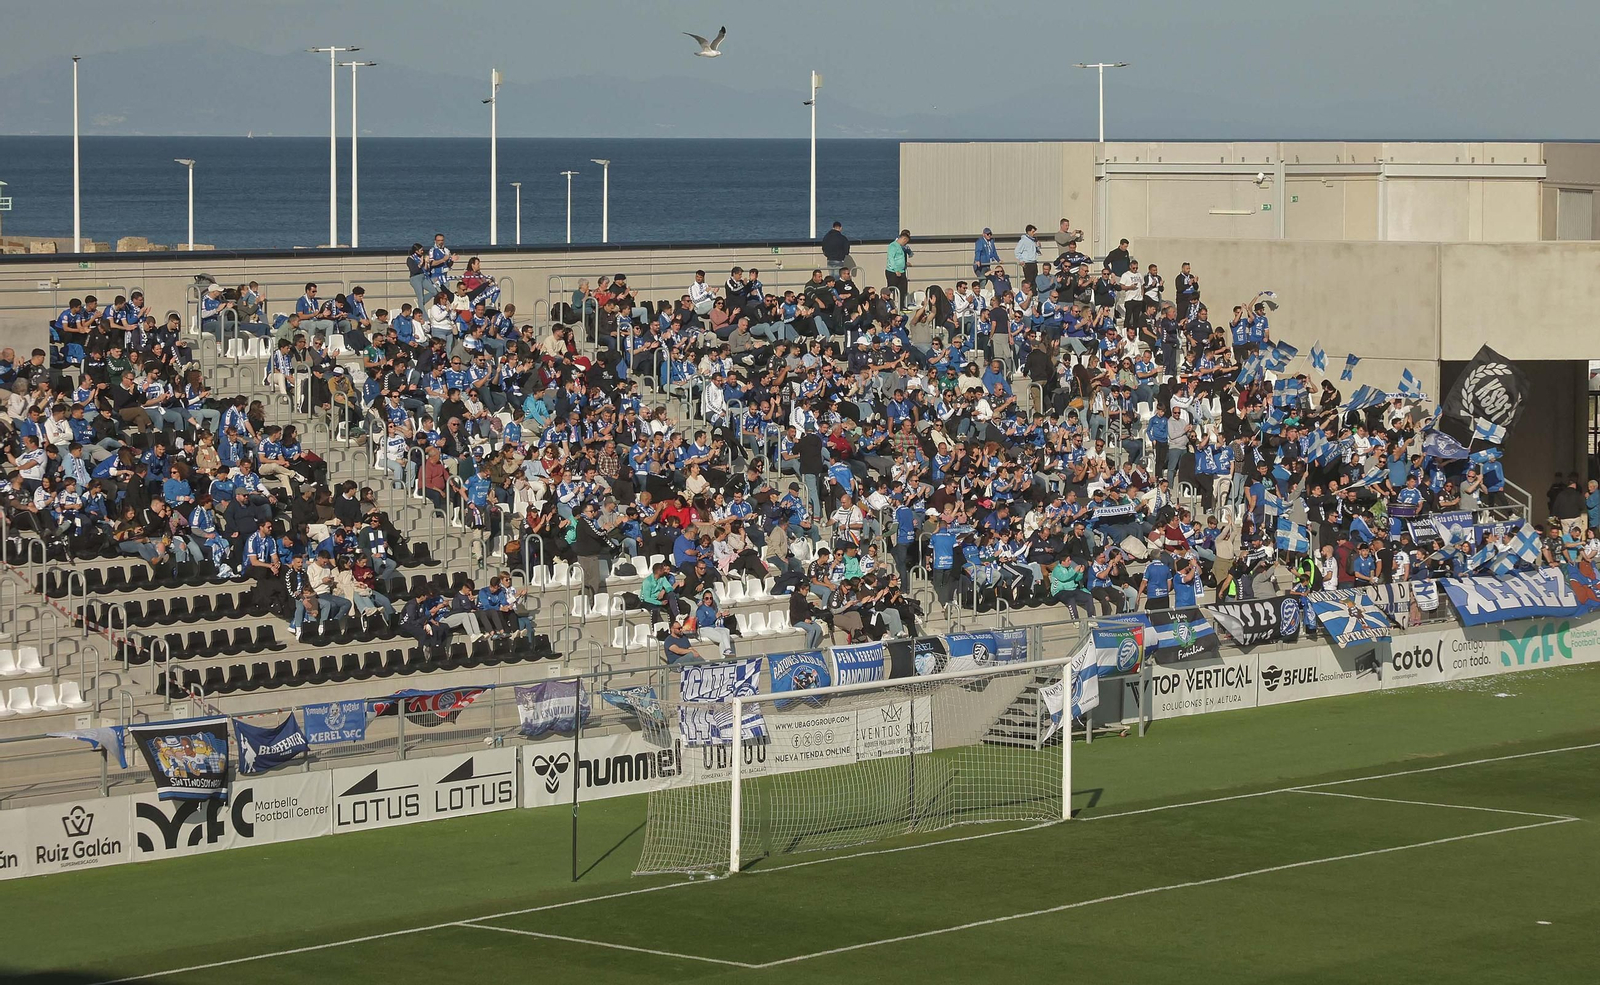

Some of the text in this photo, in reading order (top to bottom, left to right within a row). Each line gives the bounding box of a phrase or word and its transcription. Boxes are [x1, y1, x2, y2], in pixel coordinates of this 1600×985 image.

[1447, 567, 1578, 615] XEREZ
[1254, 601, 1277, 626] 23
[1571, 629, 1598, 639] Marbella
[1571, 637, 1595, 648] Football
[1177, 645, 1205, 660] Familia
[1452, 639, 1486, 653] Contigo,
[836, 649, 856, 664] PEÑA
[1393, 645, 1433, 672] coto
[1453, 654, 1491, 669] con todo.
[773, 654, 799, 680] RATONES
[1152, 663, 1252, 696] TOP VERTICAL
[1283, 666, 1352, 687] BFUEL Gasolineras
[1162, 695, 1242, 712] SOLUCIONES EN ALTURA
[309, 731, 342, 743] XEREZ
[775, 752, 799, 763] NUEVA
[800, 749, 824, 760] TIENDA
[825, 746, 850, 757] ONLINE
[577, 738, 682, 789] hummel
[254, 797, 298, 811] Marbella
[337, 780, 512, 826] LOTUS LOTUS
[255, 804, 329, 823] Football Center
[36, 837, 121, 864] Ruiz Galán
[60, 858, 99, 868] SUPERMERCADOS
